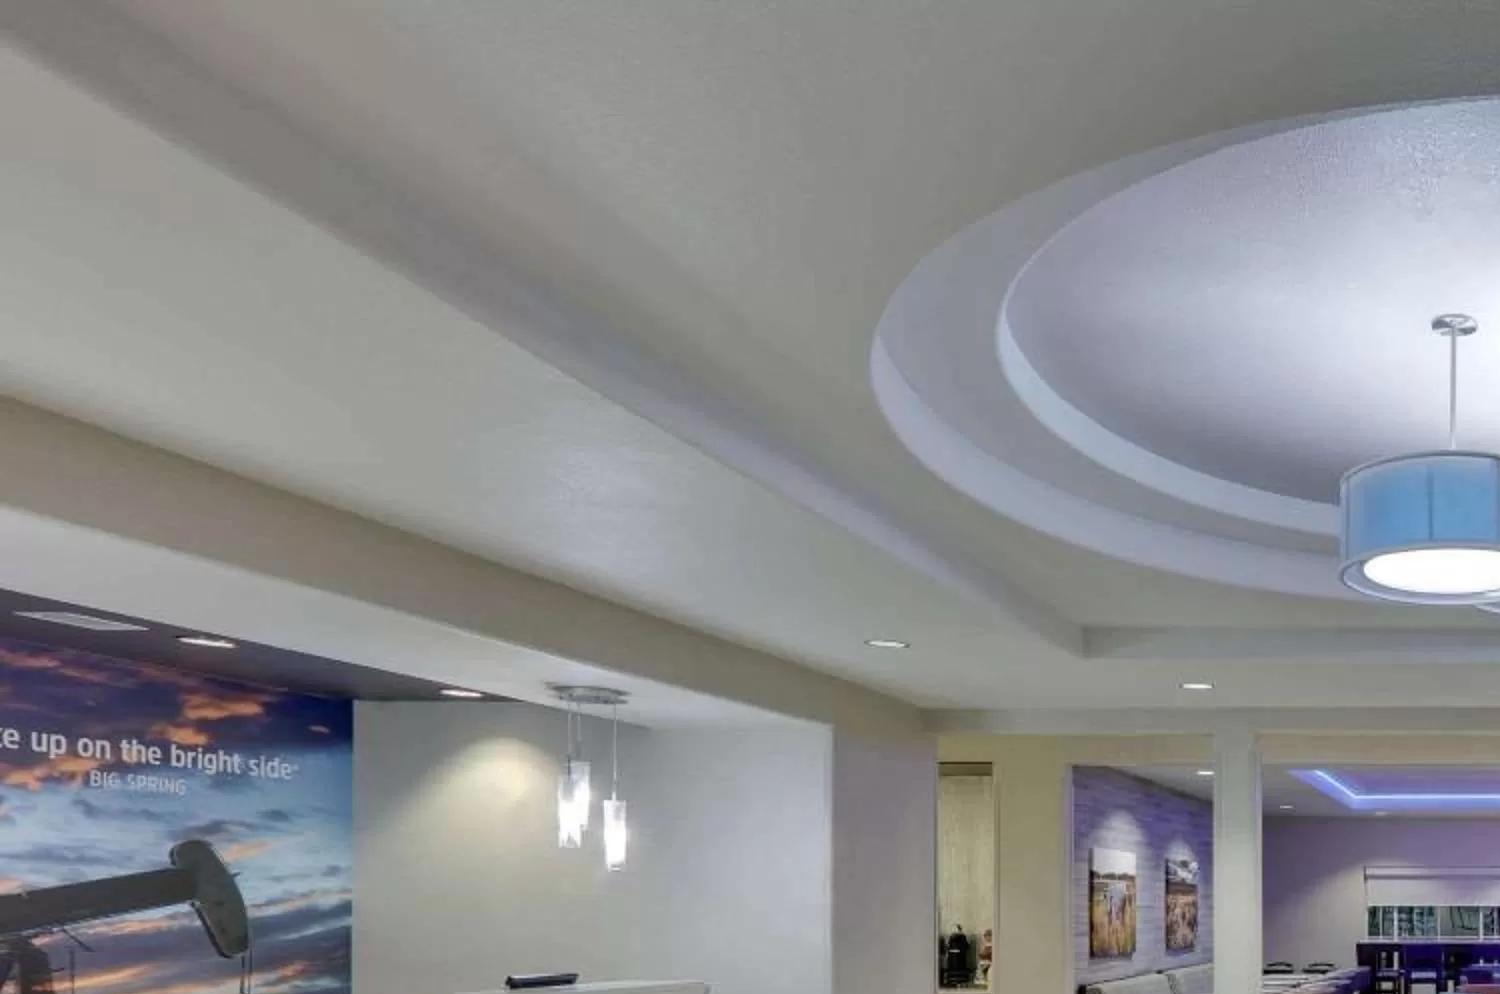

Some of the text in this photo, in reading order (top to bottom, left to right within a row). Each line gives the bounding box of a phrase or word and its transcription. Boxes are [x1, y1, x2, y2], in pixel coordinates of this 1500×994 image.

[0, 727, 20, 749] e
[31, 731, 67, 759] up
[77, 737, 111, 758] on
[120, 739, 162, 765] the
[170, 744, 240, 775] bright
[89, 769, 187, 796] BIG SPRING
